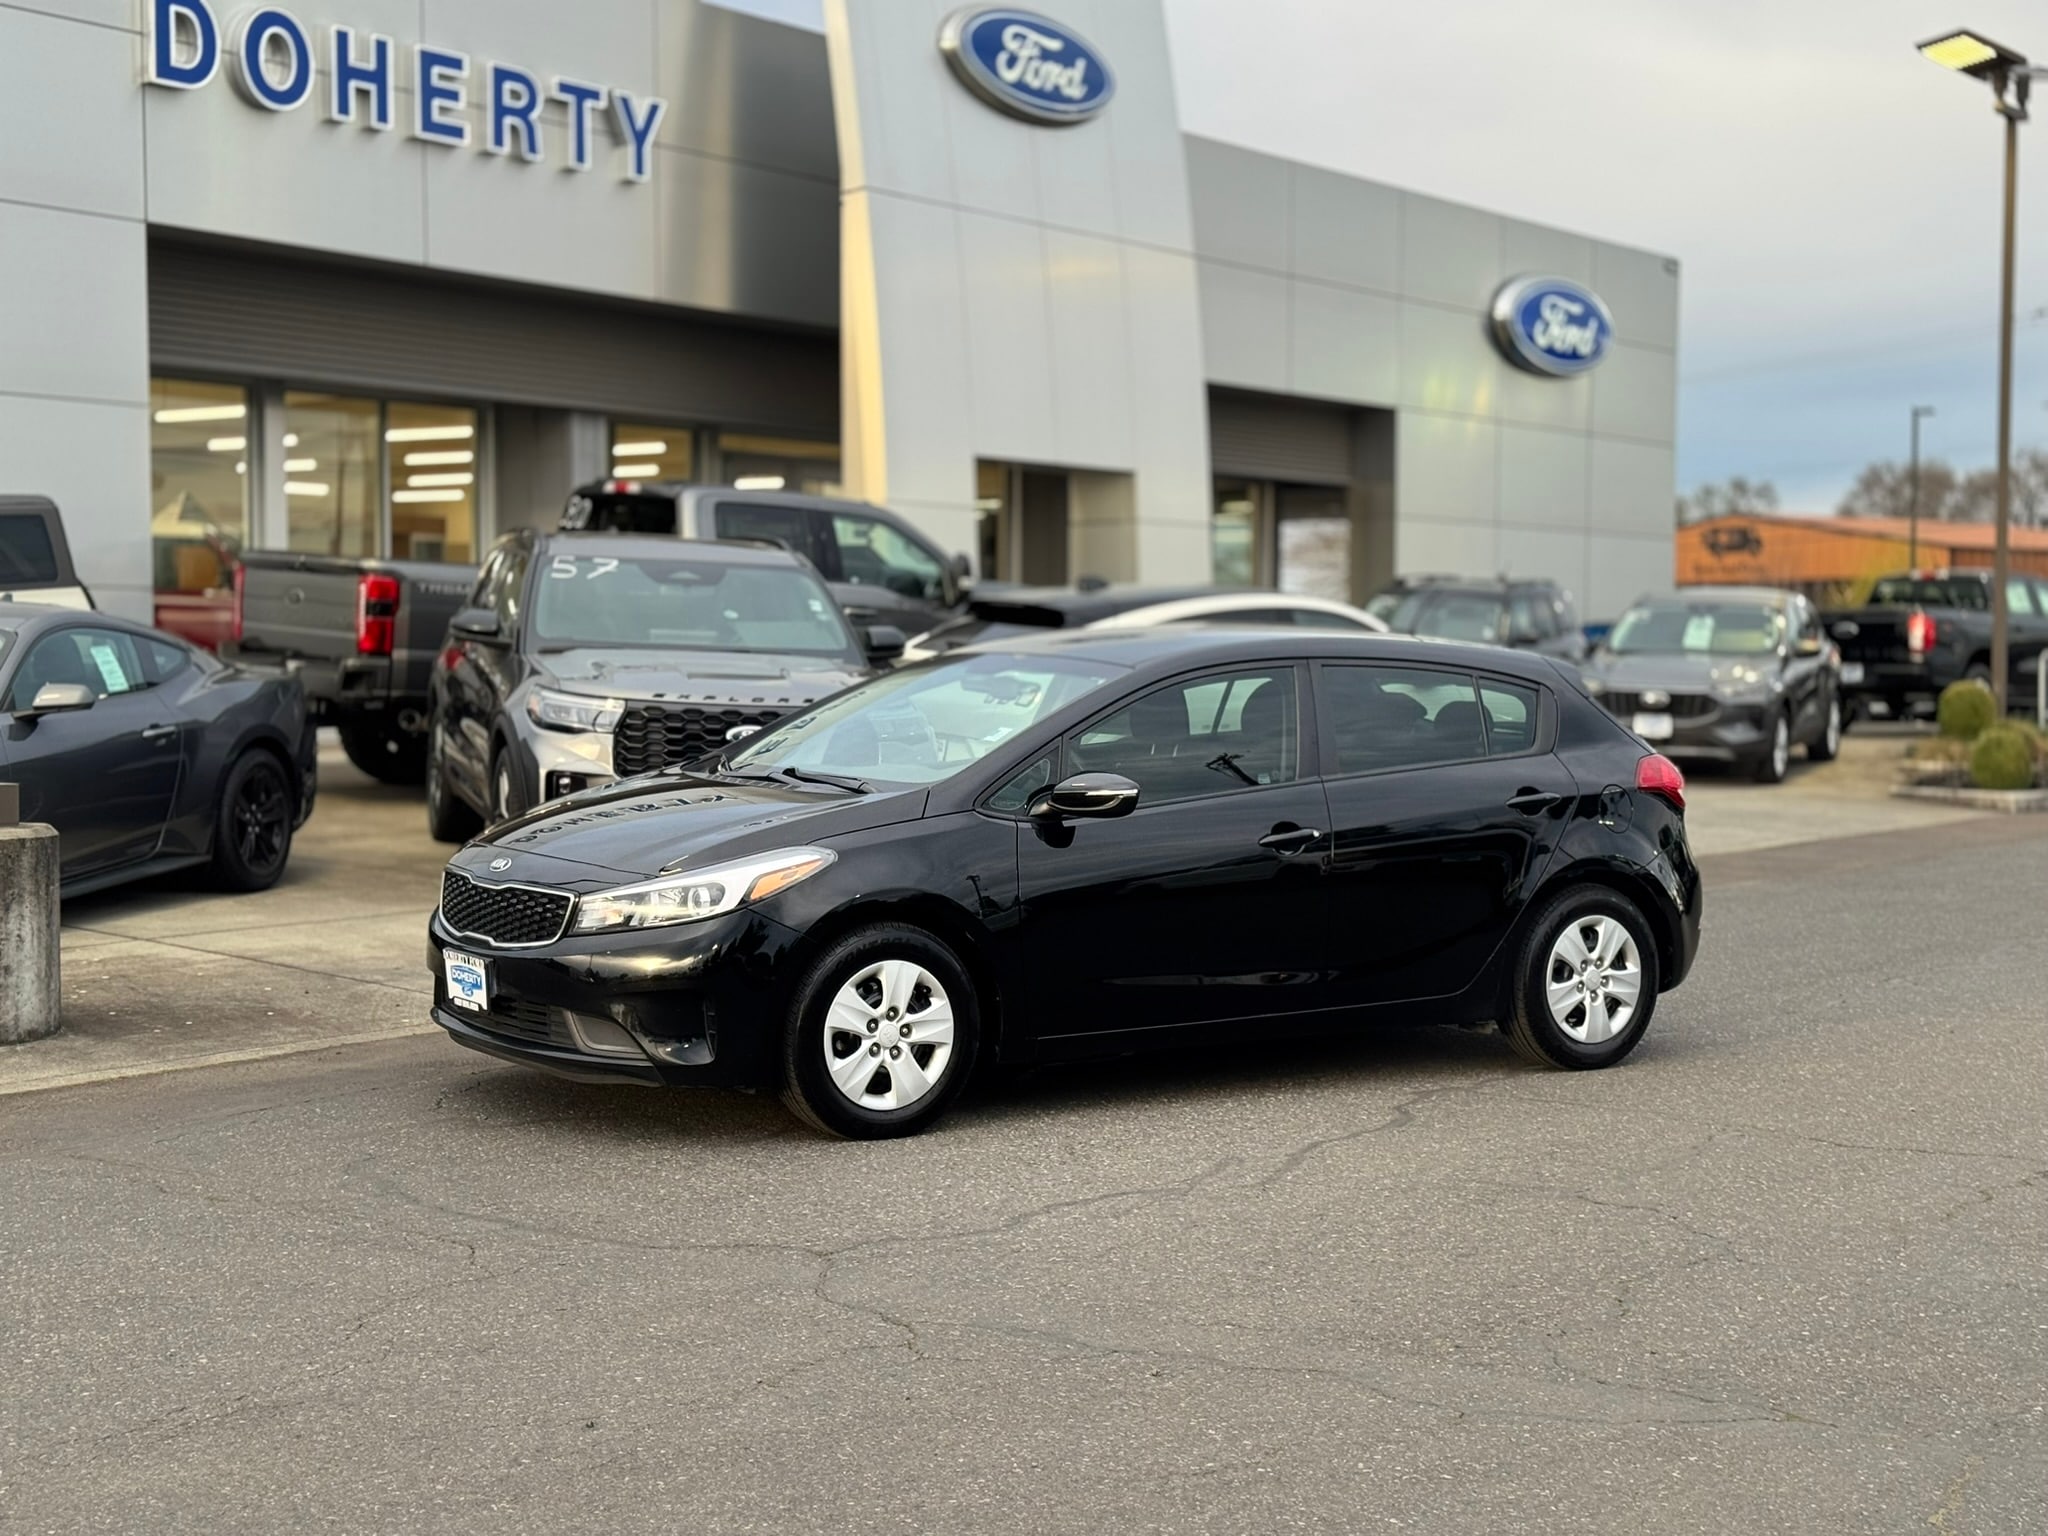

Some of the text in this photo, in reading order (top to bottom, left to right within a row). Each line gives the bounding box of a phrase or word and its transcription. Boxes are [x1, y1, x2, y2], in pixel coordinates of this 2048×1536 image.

[995, 24, 1087, 100] Ford
[149, 0, 668, 184] DOHERTY
[1533, 293, 1600, 358] Ford
[417, 581, 473, 596] TREM
[651, 692, 816, 705] EXPLORE
[451, 969, 481, 986] DOHERTY
